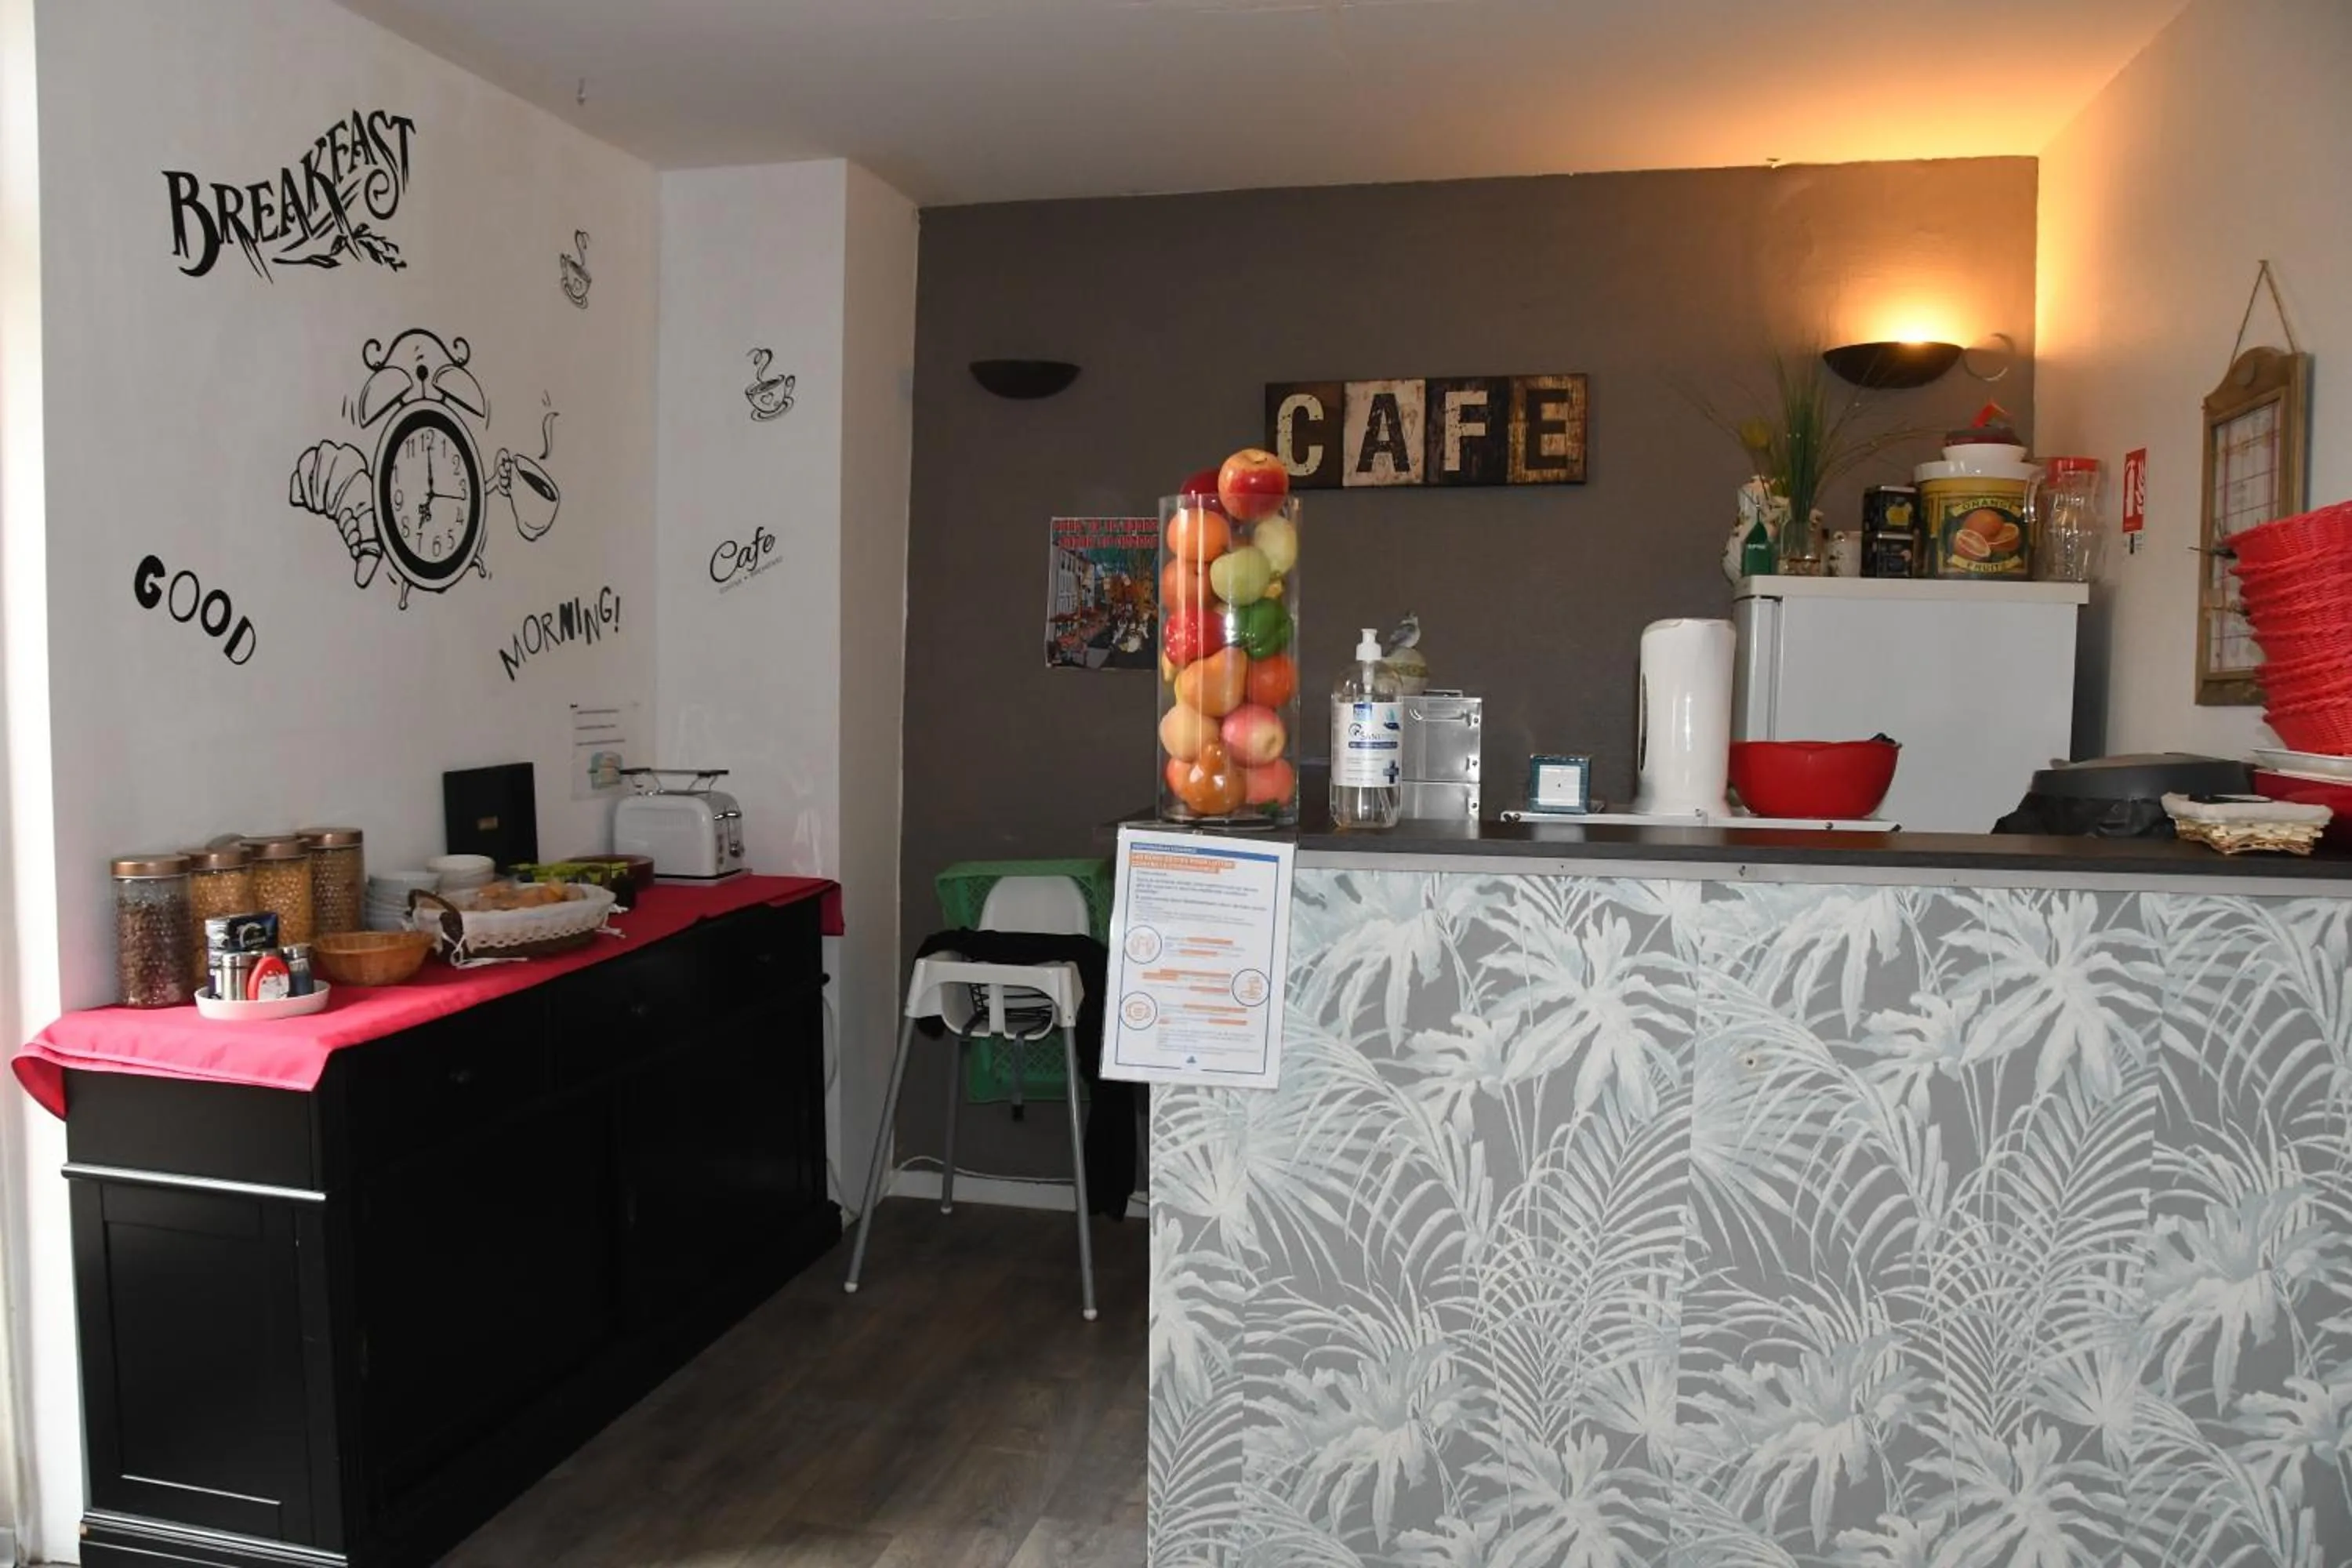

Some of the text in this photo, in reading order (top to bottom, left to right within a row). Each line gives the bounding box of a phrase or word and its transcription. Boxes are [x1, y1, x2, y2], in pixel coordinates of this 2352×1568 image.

[162, 109, 416, 283] BREAKFAST
[420, 430, 436, 452] 12
[1276, 388, 1568, 477] CAFE
[405, 438, 416, 459] 11
[441, 438, 447, 459] 1
[452, 454, 461, 476] 2
[394, 488, 405, 512] 9
[459, 478, 466, 500] 3
[455, 506, 465, 526] 4
[416, 532, 423, 554] 7
[431, 535, 442, 557] 6
[447, 529, 456, 550] 5
[710, 526, 775, 583] Cafe
[133, 555, 256, 666] GOOD
[499, 586, 621, 681] MORNING!
